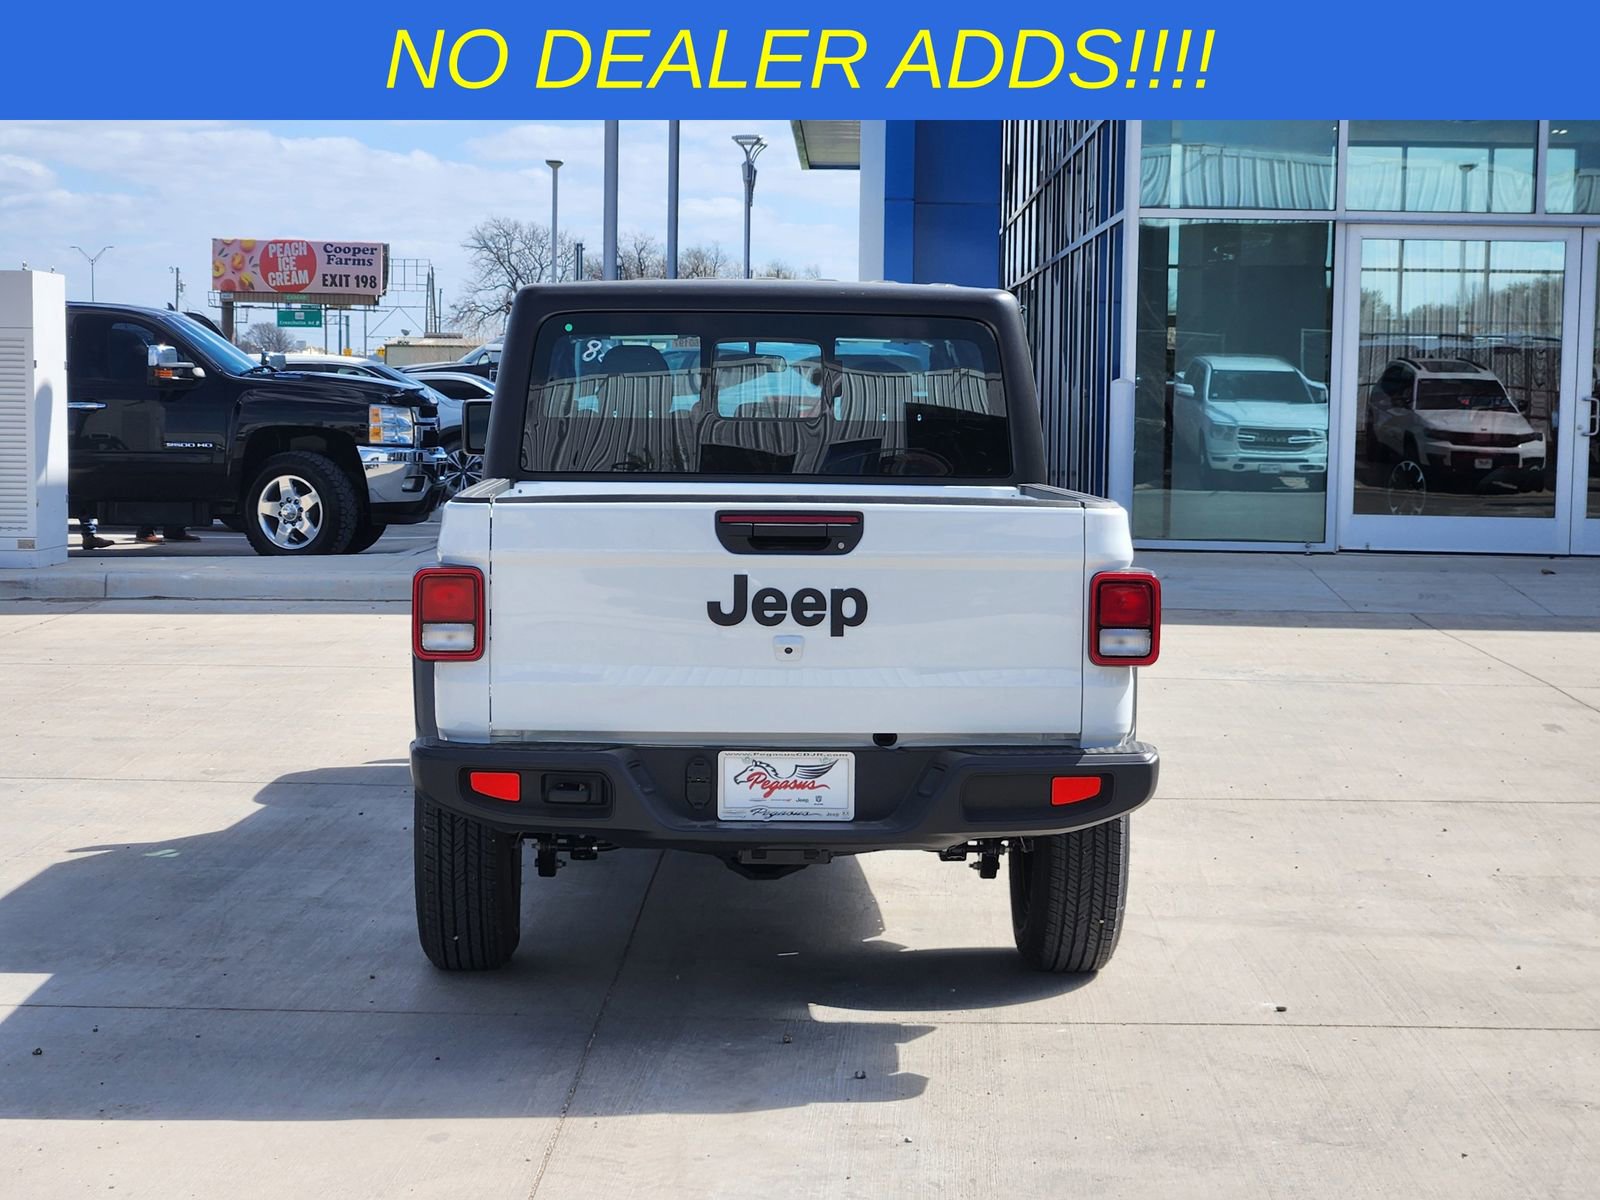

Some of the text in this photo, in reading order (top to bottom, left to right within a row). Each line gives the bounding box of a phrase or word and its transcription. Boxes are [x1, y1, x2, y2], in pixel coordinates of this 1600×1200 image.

[268, 241, 307, 258] PEACH
[323, 243, 377, 257] Cooper
[277, 256, 297, 272] ICE
[326, 254, 374, 267] Farms
[268, 269, 309, 287] CREAM
[322, 273, 377, 289] EXIT 198
[707, 574, 868, 637] Jeep
[747, 771, 831, 799] Pegasus
